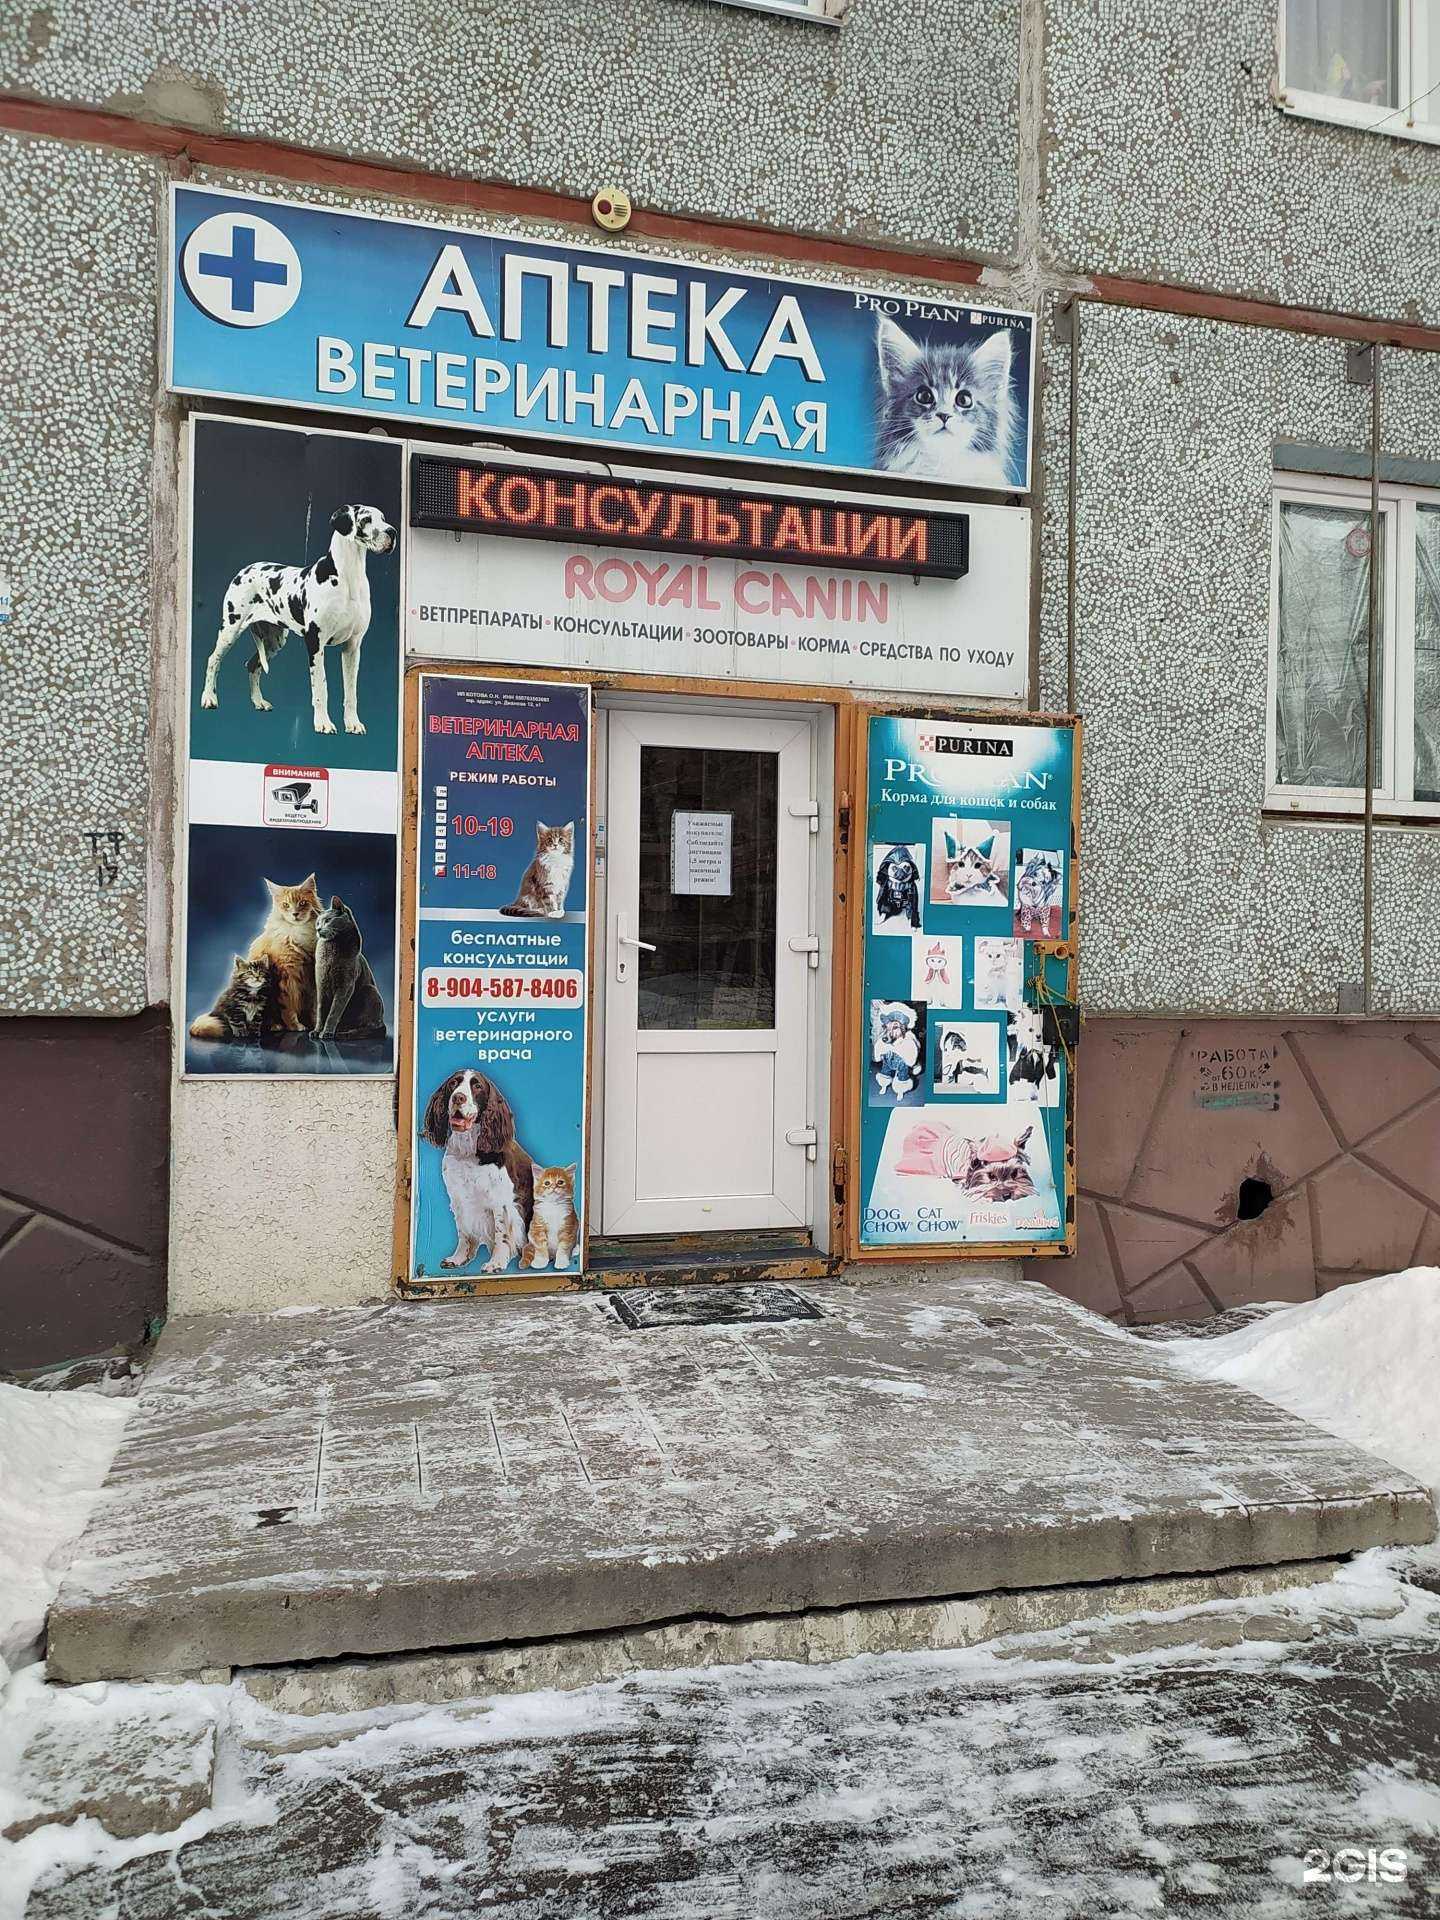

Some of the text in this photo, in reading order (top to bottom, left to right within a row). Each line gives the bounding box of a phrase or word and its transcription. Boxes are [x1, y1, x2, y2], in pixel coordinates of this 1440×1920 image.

[407, 244, 827, 381] АПТЕКА
[854, 293, 960, 324] PRO PLAN
[982, 315, 1025, 329] PURINA
[316, 336, 828, 453] ВЕТЕРИНАРНАЯ
[457, 468, 928, 562] КОНСУЛЬТАЦИИ
[564, 554, 889, 624] ROYAL CANIN
[418, 604, 1014, 668] ВЕТПРЕПАРАТЫ КОНСУЛЬТАЦИИ ЗООТОВАРЫ КОРМА СРЕДСТВА ПО УХОДУ
[429, 715, 579, 742] ВЕТЕРИНАРНАЯ
[466, 741, 544, 762] АПТЕКА
[938, 738, 1011, 756] PURINA
[272, 768, 321, 778] ВНИМАНИЕ
[450, 771, 556, 787] РЕЖИМ РАБОТЫ
[881, 788, 1057, 811] Корма для кошек и собак
[452, 815, 514, 837] 10-19
[453, 864, 497, 880] 11-18
[451, 930, 562, 946] бесплатные
[443, 952, 568, 967] консультации
[427, 977, 578, 999] 8-904-587-8406
[476, 1011, 536, 1025] услуги
[436, 1029, 573, 1044] ветеринарного
[478, 1049, 532, 1062] врача
[1197, 1048, 1269, 1063] РАБОТА
[864, 1207, 943, 1220] DOG CAT
[863, 1219, 960, 1233] CHOW CHOW
